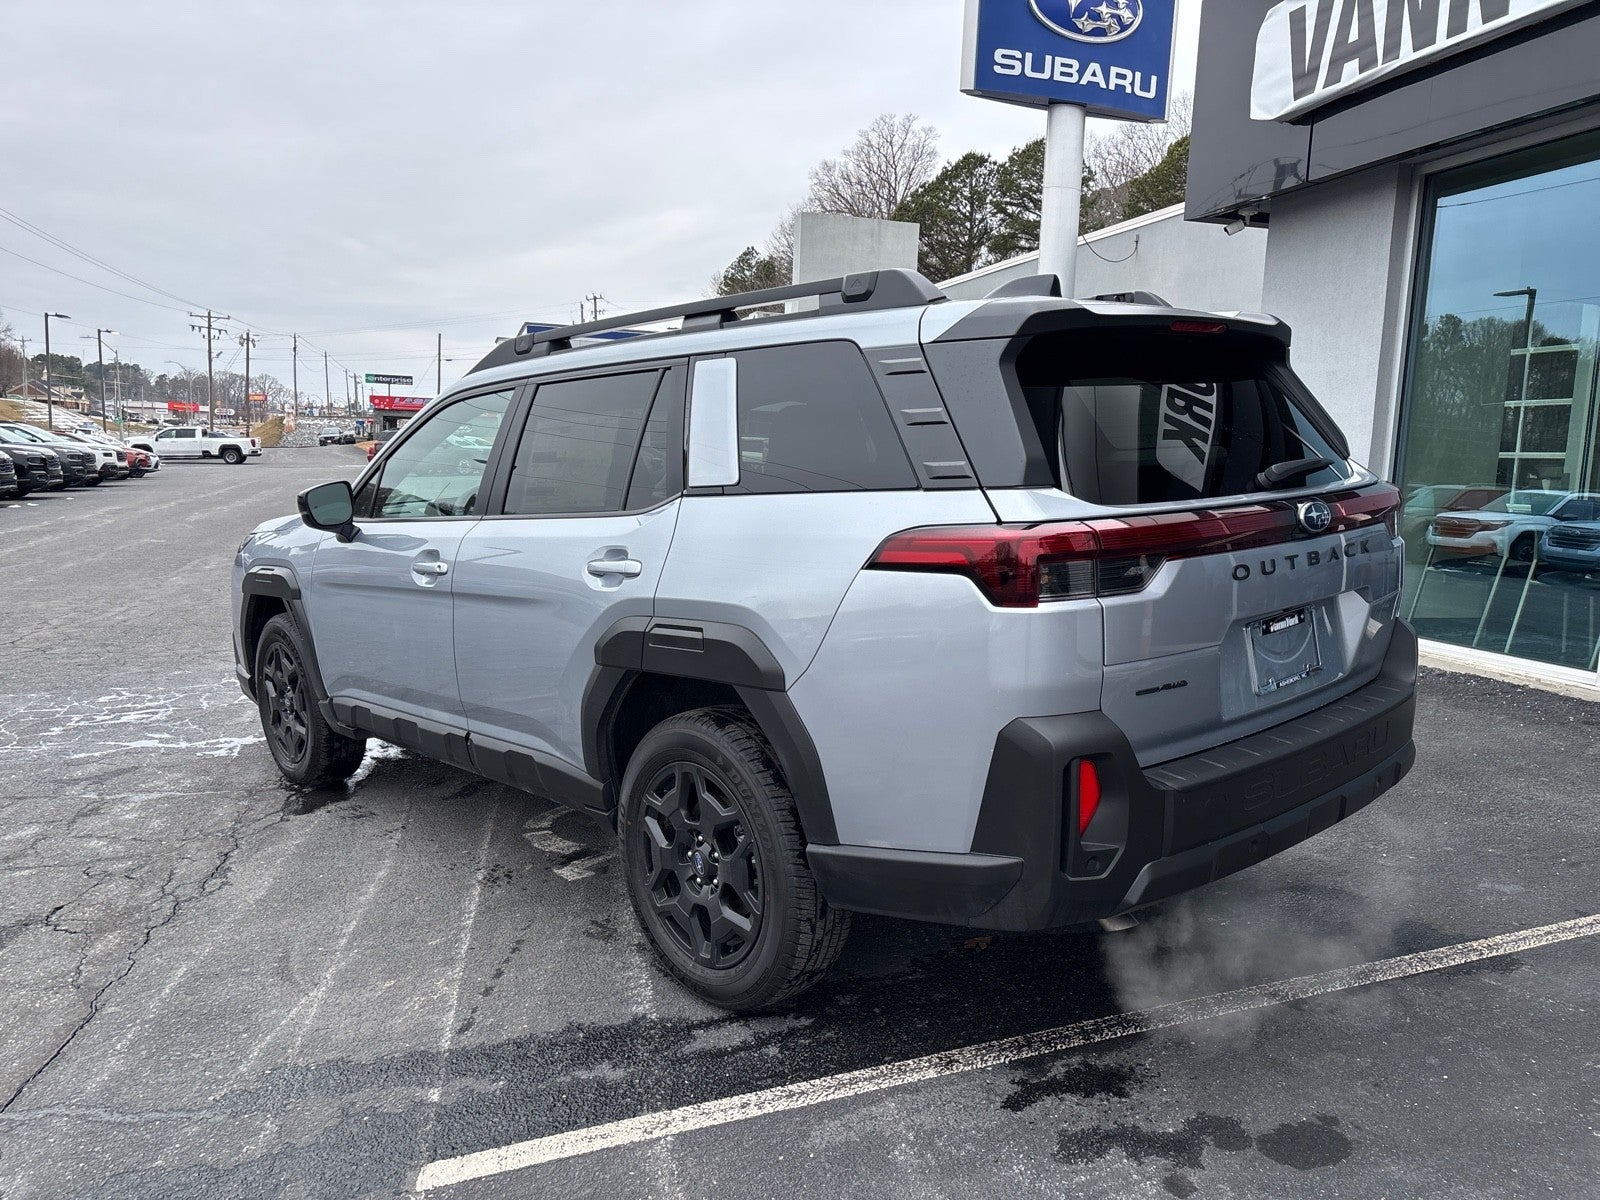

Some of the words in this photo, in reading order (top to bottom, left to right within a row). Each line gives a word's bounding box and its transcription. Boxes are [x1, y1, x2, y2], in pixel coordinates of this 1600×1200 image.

[993, 48, 1158, 99] SUBARU
[1231, 539, 1371, 581] OUTBACK
[1244, 719, 1390, 811] SUBARU
